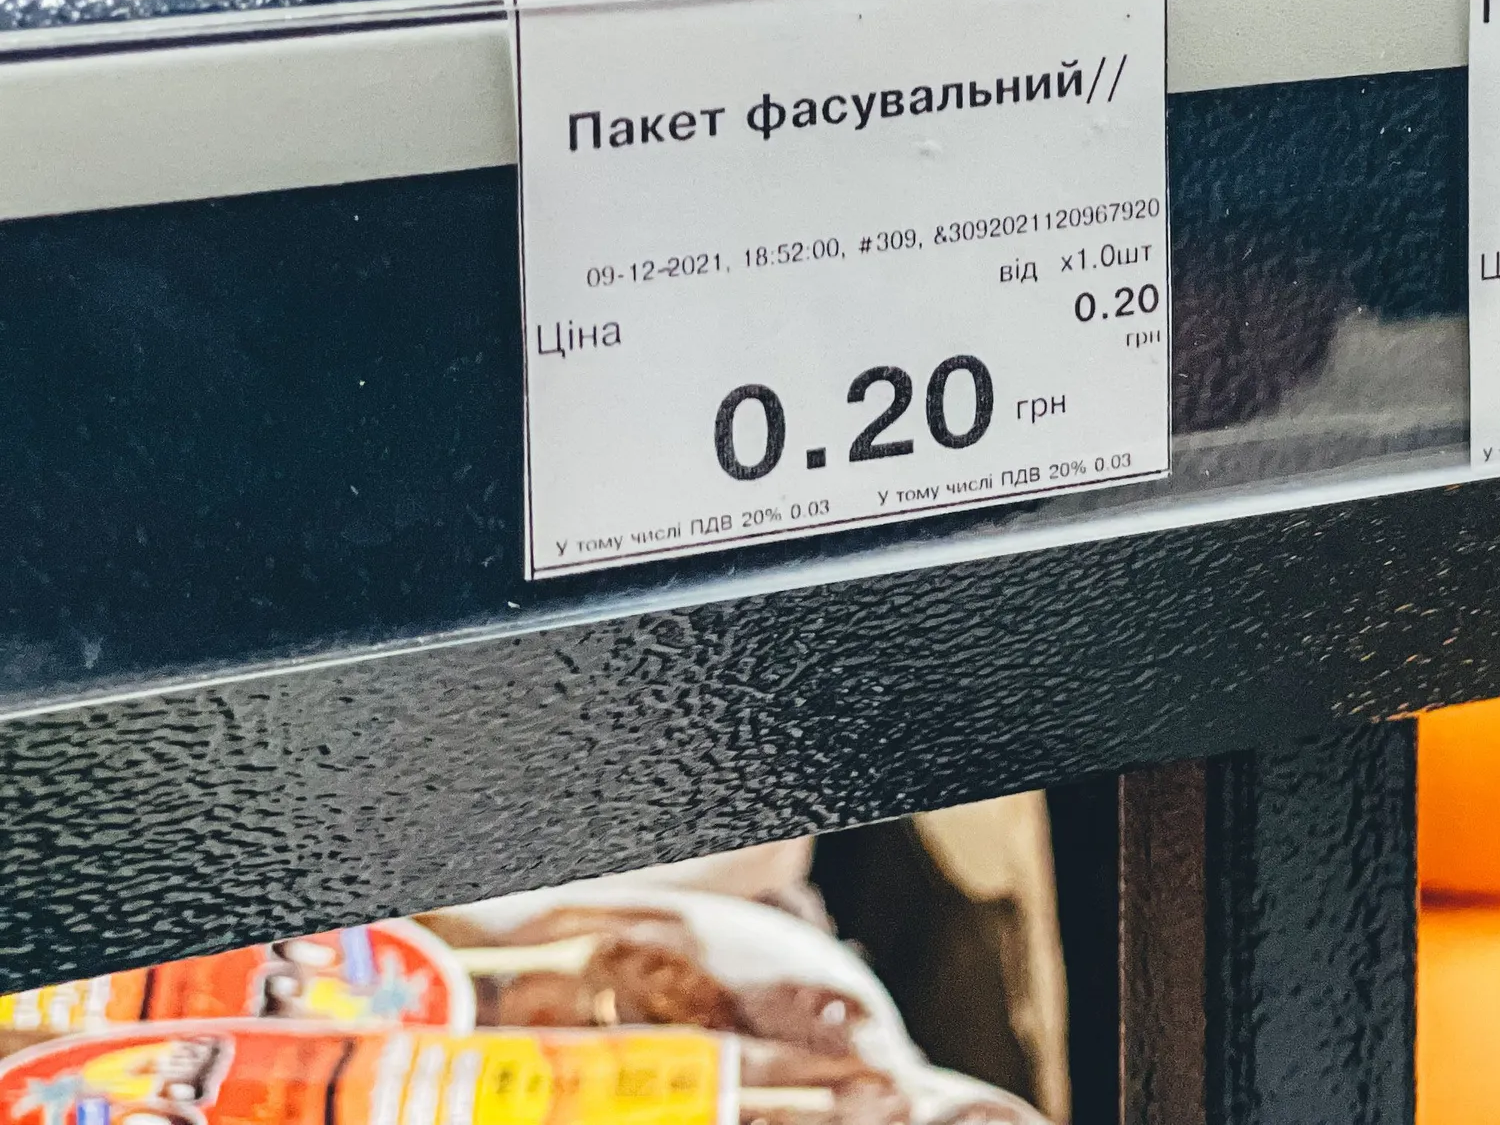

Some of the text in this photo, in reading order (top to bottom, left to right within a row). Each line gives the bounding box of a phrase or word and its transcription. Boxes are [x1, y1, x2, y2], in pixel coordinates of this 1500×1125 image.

[568, 54, 1127, 152] Пакет фасувальний//
[587, 197, 1160, 287] 09-12-2021, 18:52:00, #309, &3092021120967920
[999, 258, 1038, 284] від
[1074, 283, 1159, 322] 0.20
[537, 321, 622, 358] Ціна
[1126, 329, 1160, 349] грн
[714, 355, 1067, 481] 0.20 грн
[1483, 448, 1492, 462] У
[878, 453, 1132, 505] У тому числі ПДВ 20% 0.03
[556, 499, 830, 556] У тому числі ПДВ 20% 0.03
